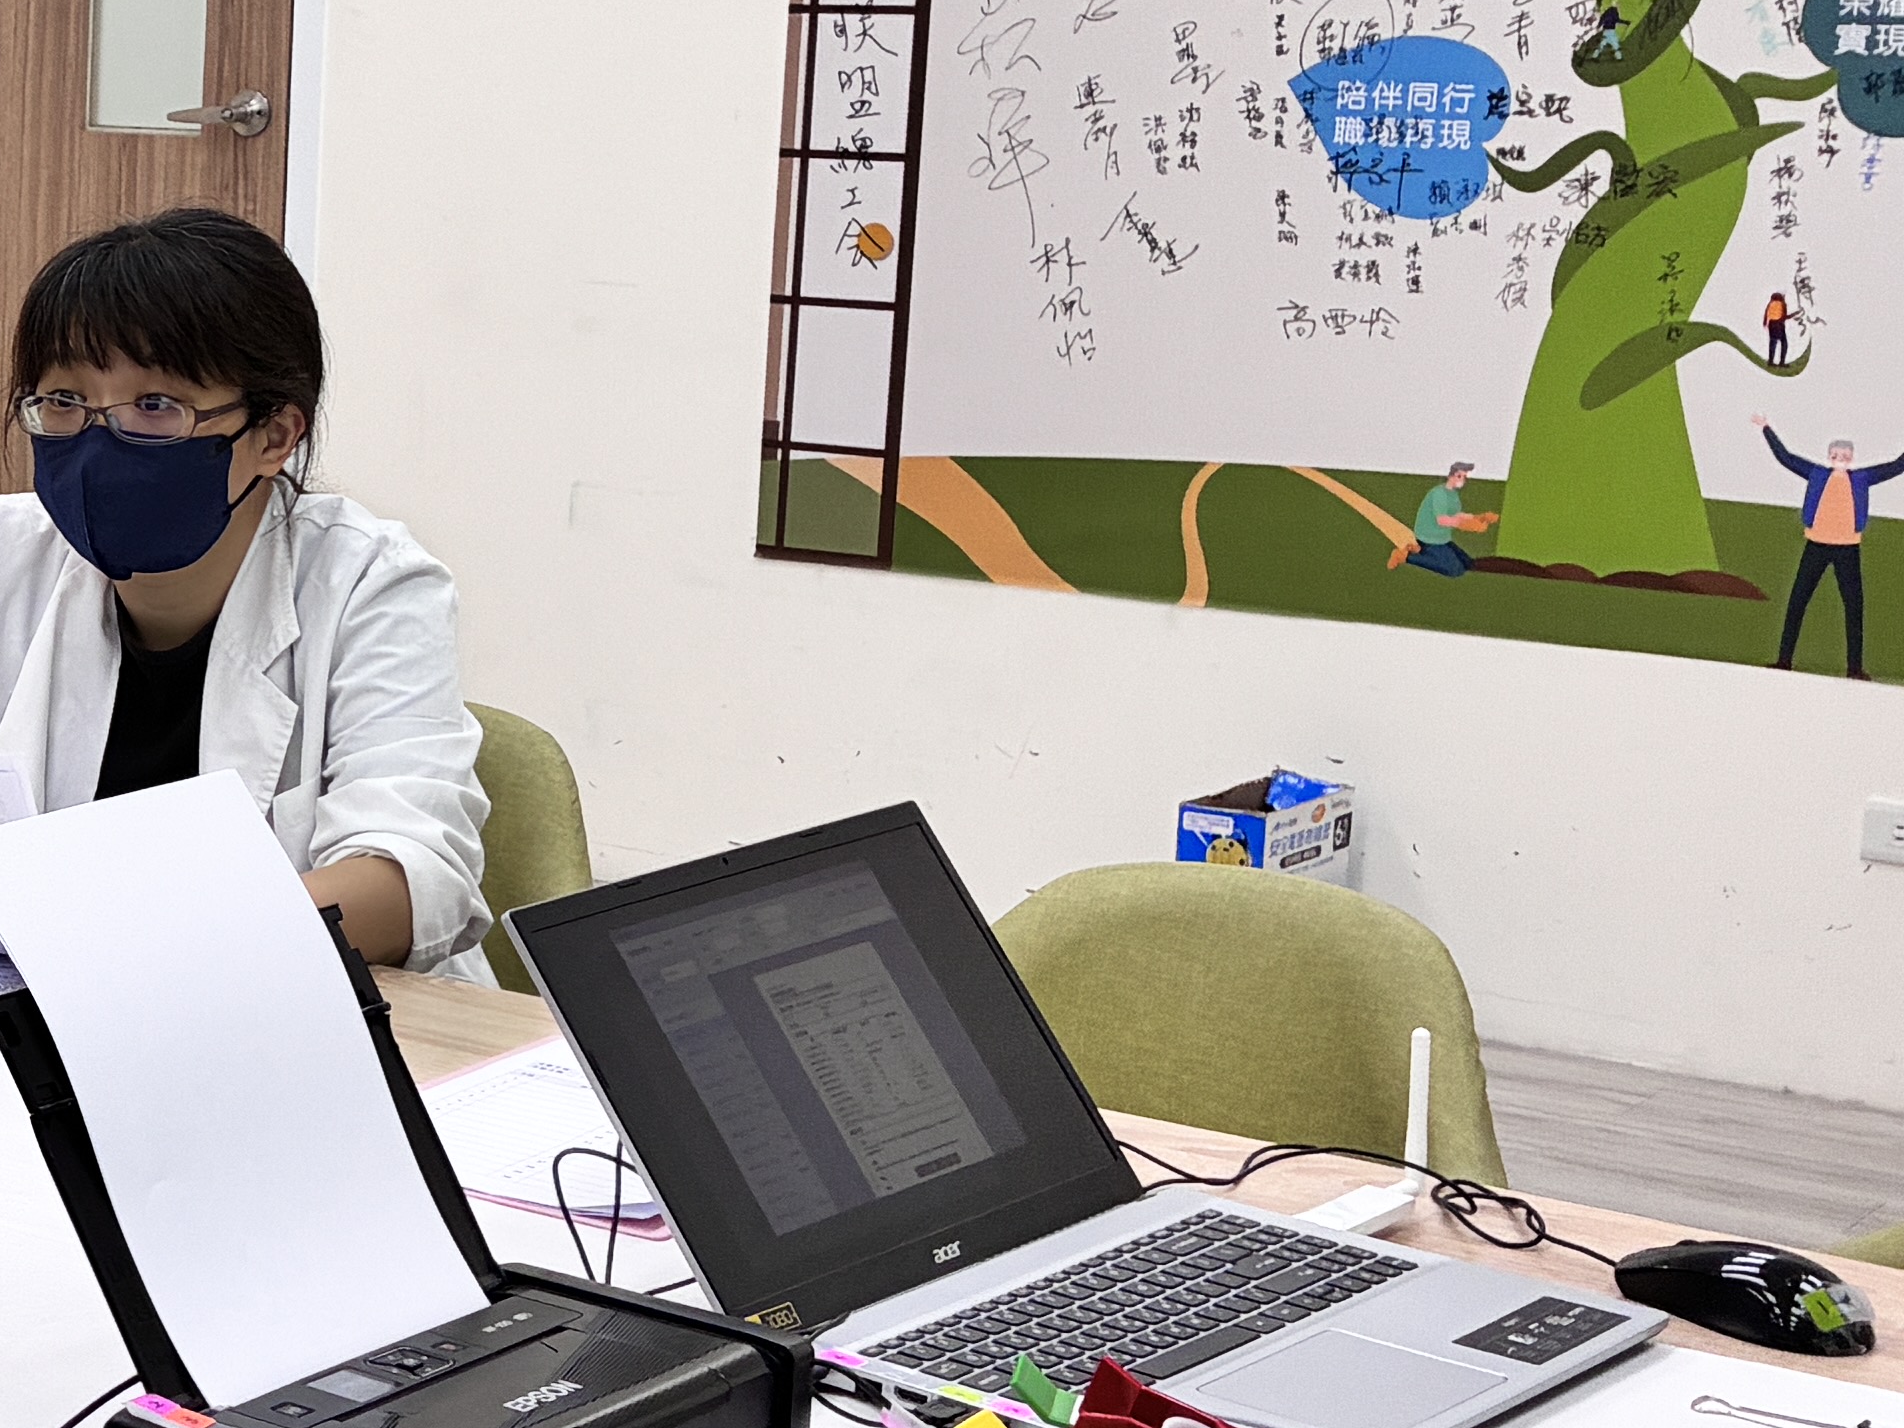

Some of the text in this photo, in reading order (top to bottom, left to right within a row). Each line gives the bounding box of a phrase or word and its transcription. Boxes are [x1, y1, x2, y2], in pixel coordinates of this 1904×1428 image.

[1335, 80, 1476, 114] 陪伴同行
[932, 1239, 962, 1265] acer
[502, 1378, 584, 1413] EPSON
